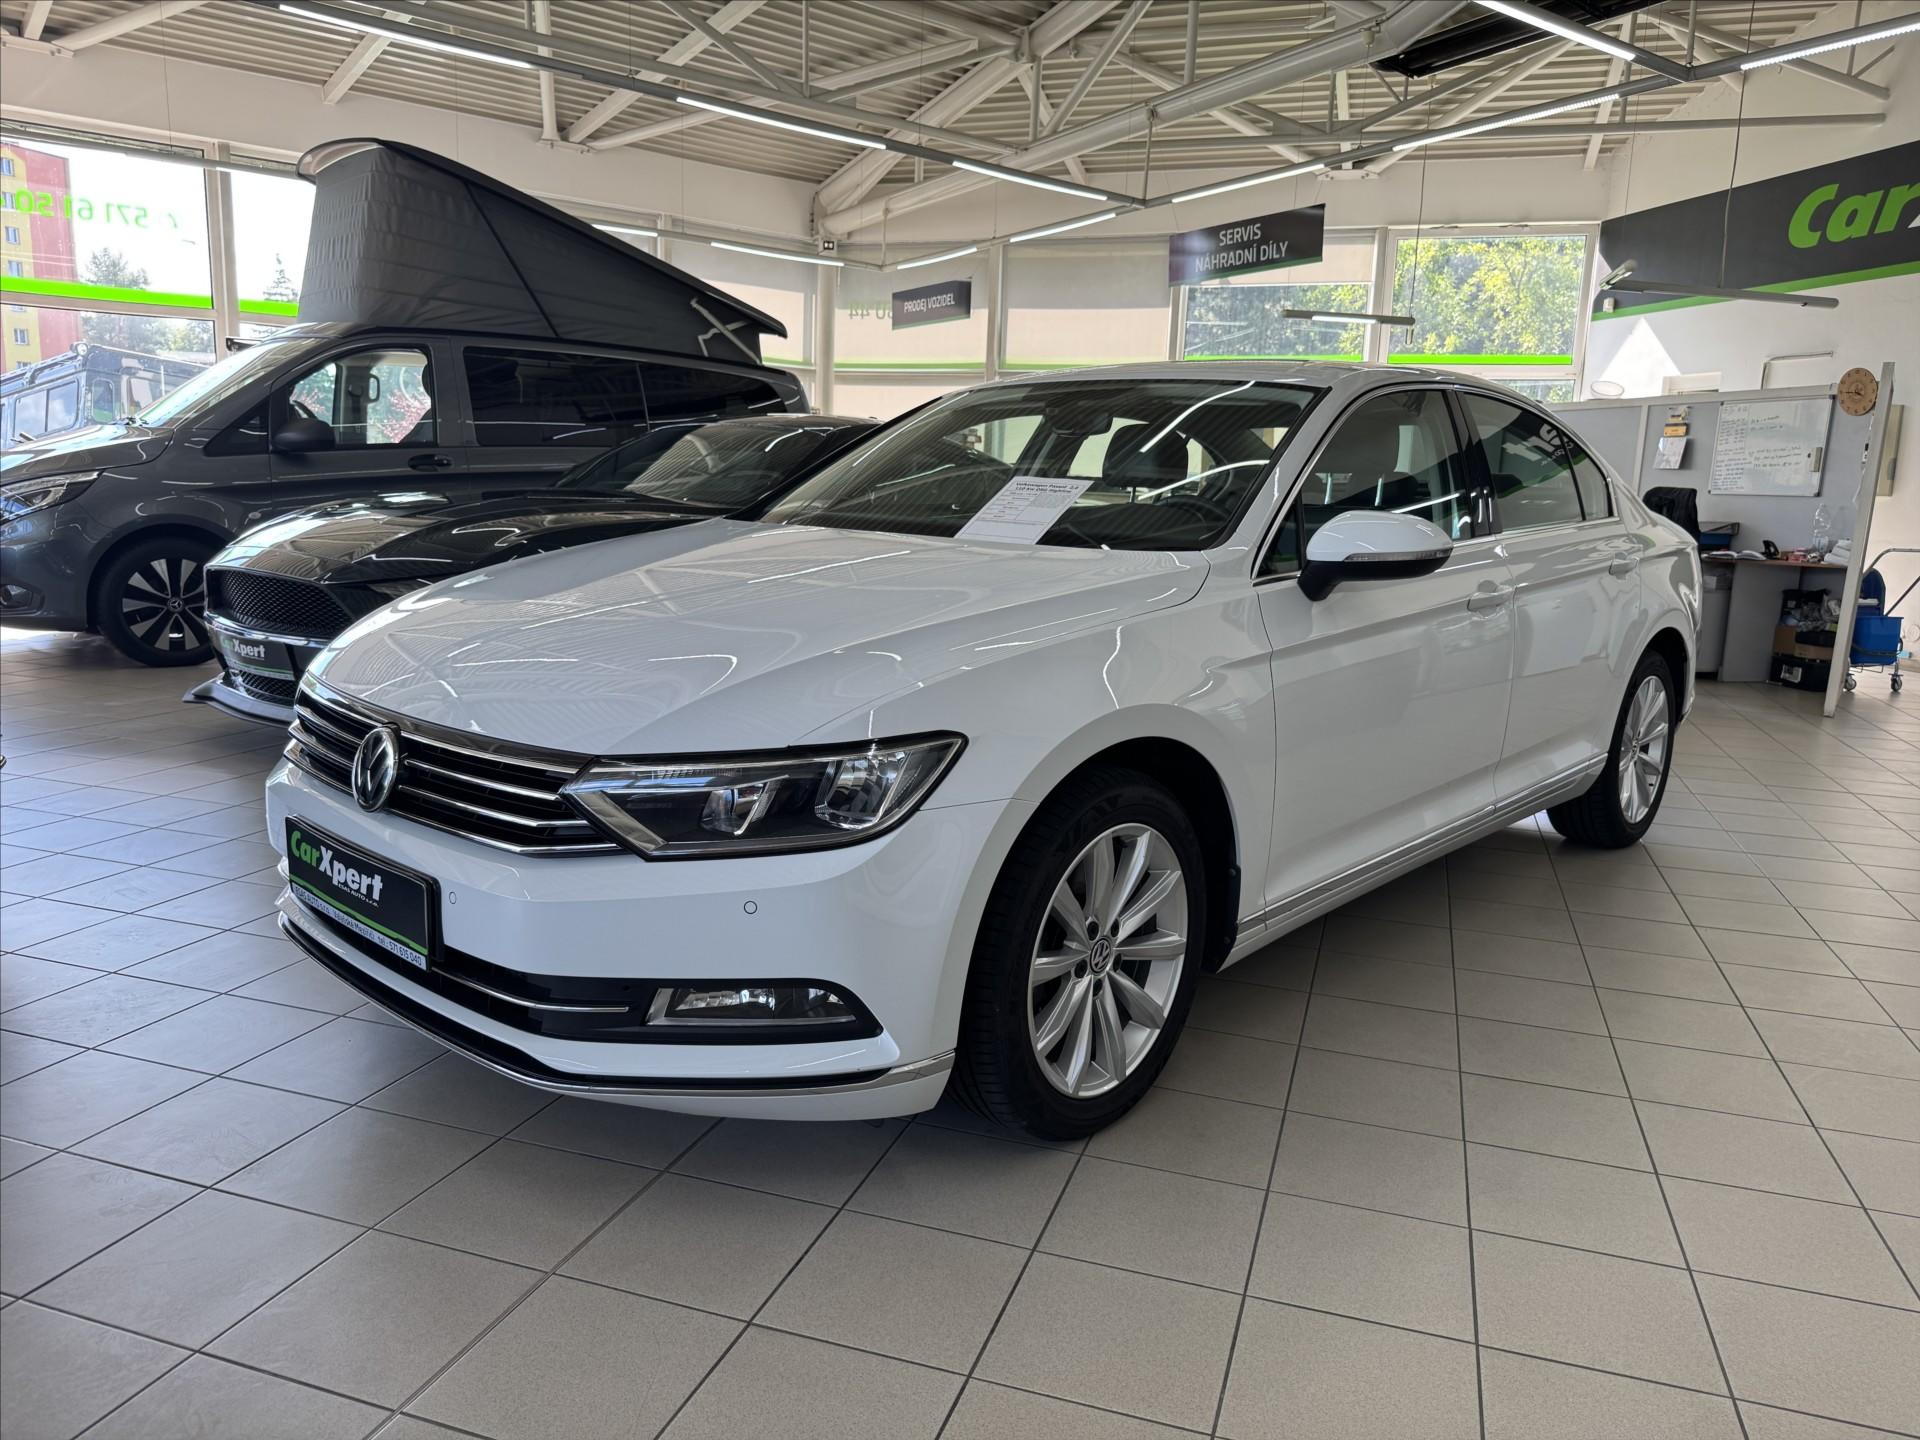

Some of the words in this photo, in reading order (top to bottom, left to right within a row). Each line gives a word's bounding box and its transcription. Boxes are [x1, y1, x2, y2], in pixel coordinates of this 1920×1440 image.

[1788, 183, 1920, 249] Car
[1219, 223, 1262, 247] SERVIS
[1195, 243, 1257, 273] NÁHRADNÍ
[1260, 240, 1289, 262] DÍLY
[903, 299, 927, 313] PRODEJ
[927, 292, 956, 310] VOZIDEL
[222, 638, 265, 658] Xpert
[291, 830, 383, 901] CarXpert
[389, 941, 400, 953] 571
[409, 951, 422, 966] 040
